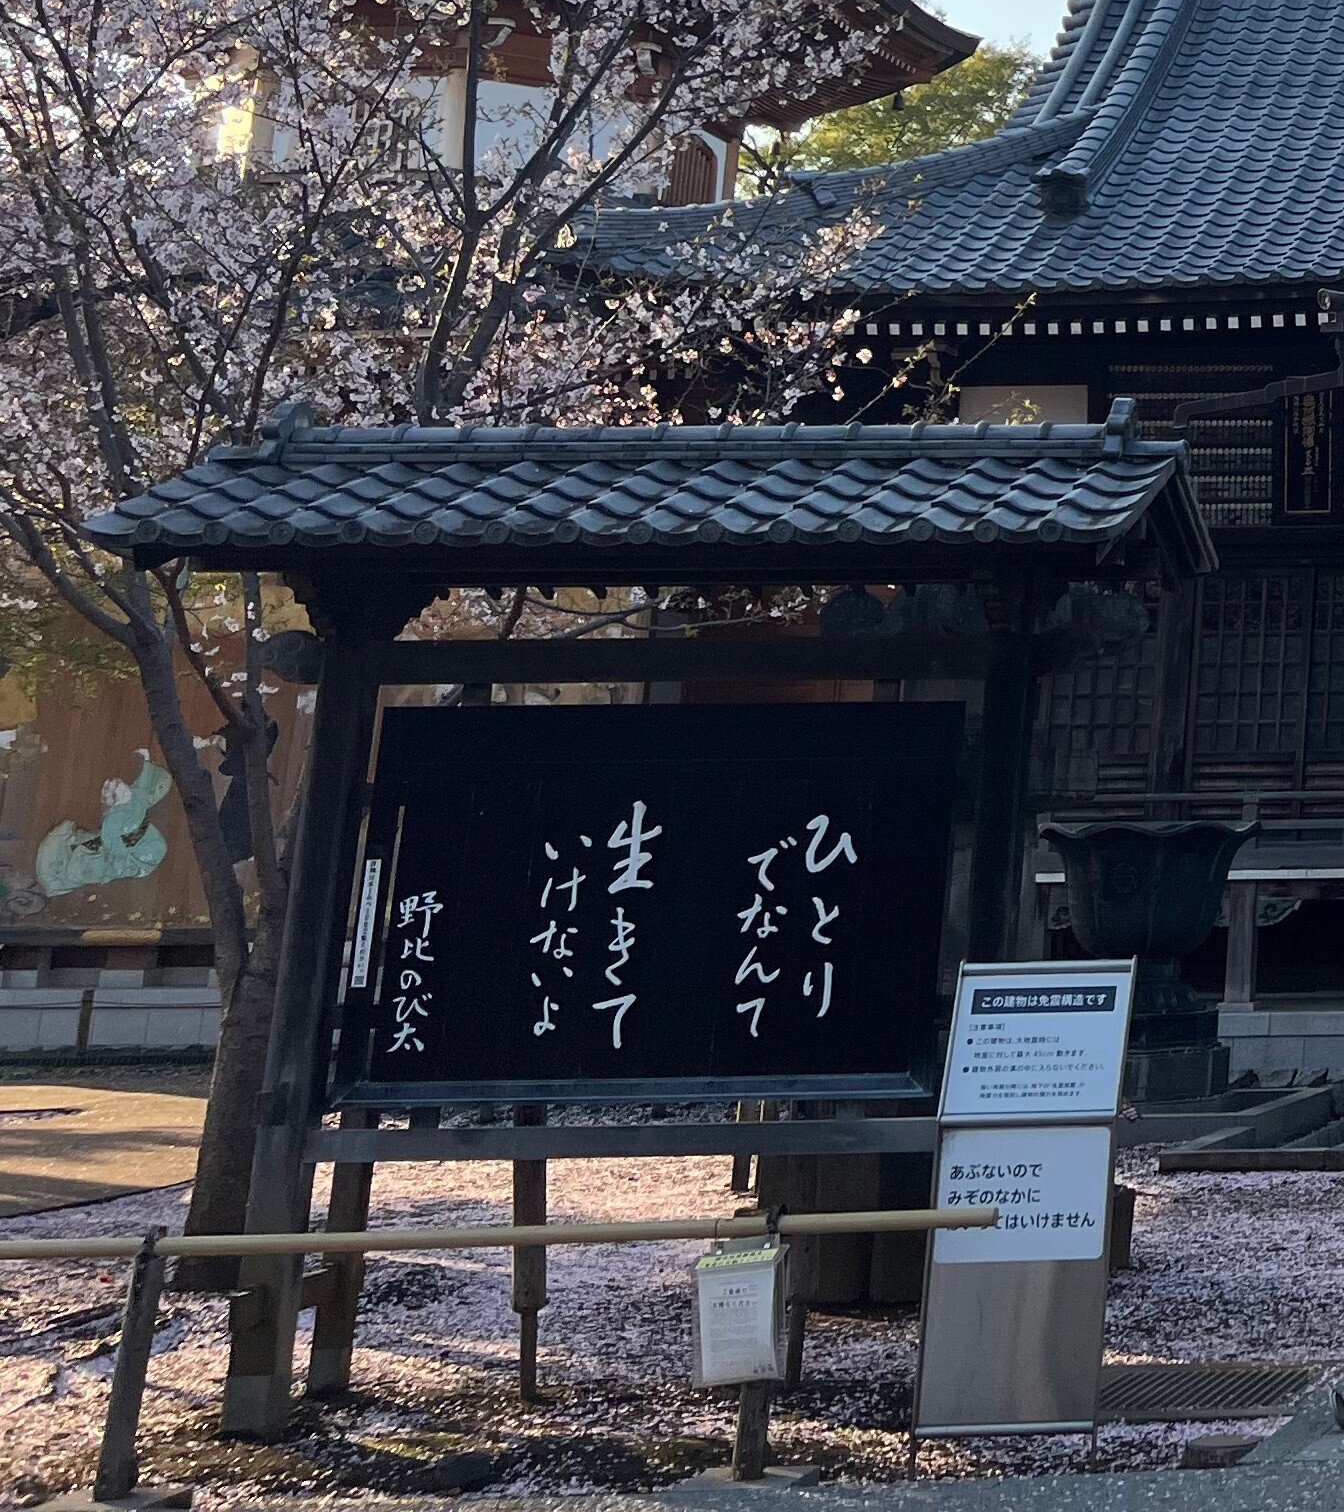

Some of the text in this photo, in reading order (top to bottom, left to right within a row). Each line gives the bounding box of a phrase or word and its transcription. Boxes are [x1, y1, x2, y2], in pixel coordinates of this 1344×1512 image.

[385, 890, 444, 1053] 野比のび太
[529, 834, 593, 1037] いけないよ
[591, 800, 663, 1049] 生きて
[735, 836, 798, 1038] でなんて
[802, 814, 858, 1018] ひとり
[981, 992, 1108, 1009] この建物は免震構造です
[947, 1187, 1042, 1206] みぞのなかに
[949, 1163, 1043, 1180] あぶないので
